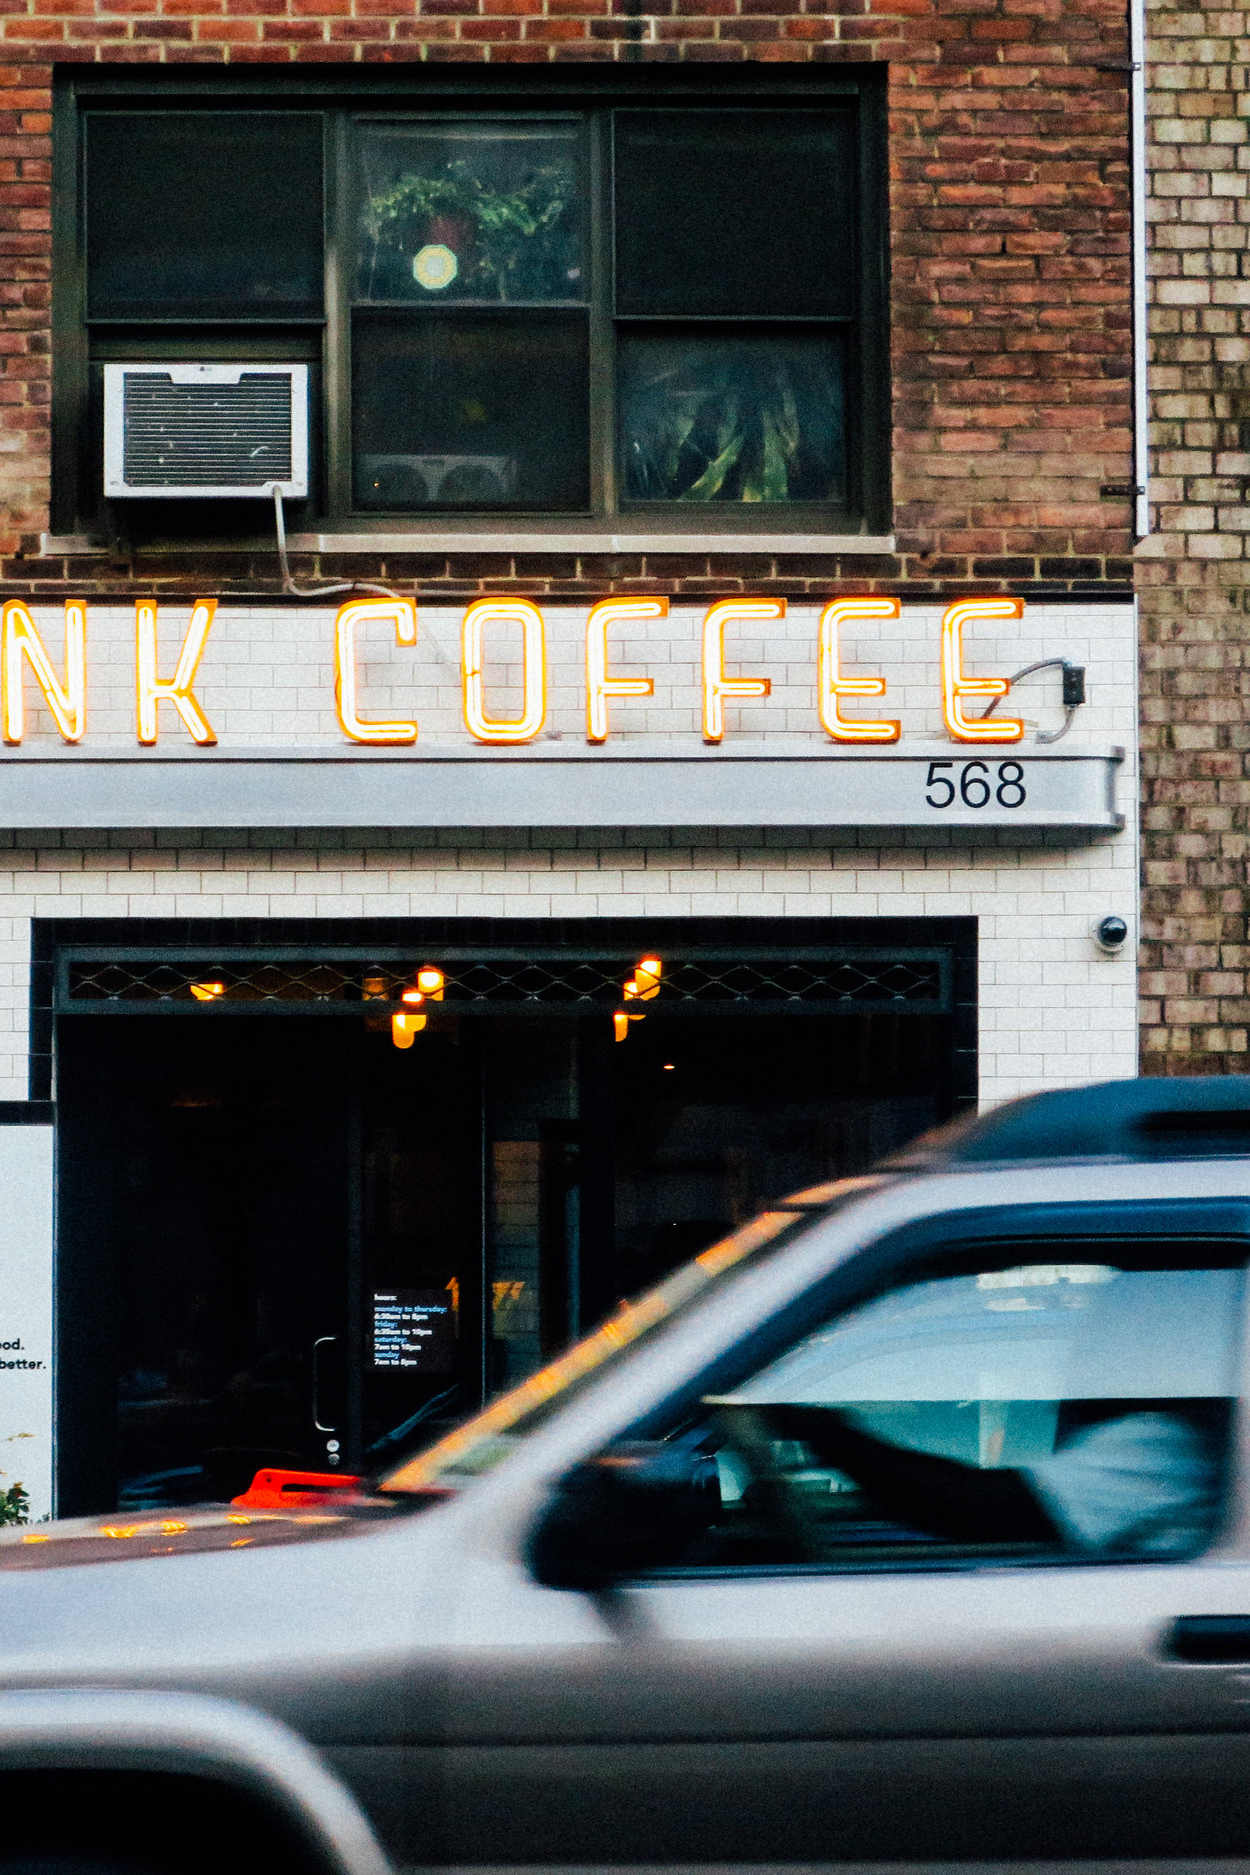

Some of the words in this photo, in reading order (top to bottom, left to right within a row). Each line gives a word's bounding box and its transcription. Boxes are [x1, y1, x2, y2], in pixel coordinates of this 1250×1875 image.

[334, 597, 1024, 744] COFFEE
[926, 761, 1026, 808] 568
[374, 1305, 403, 1313] monday
